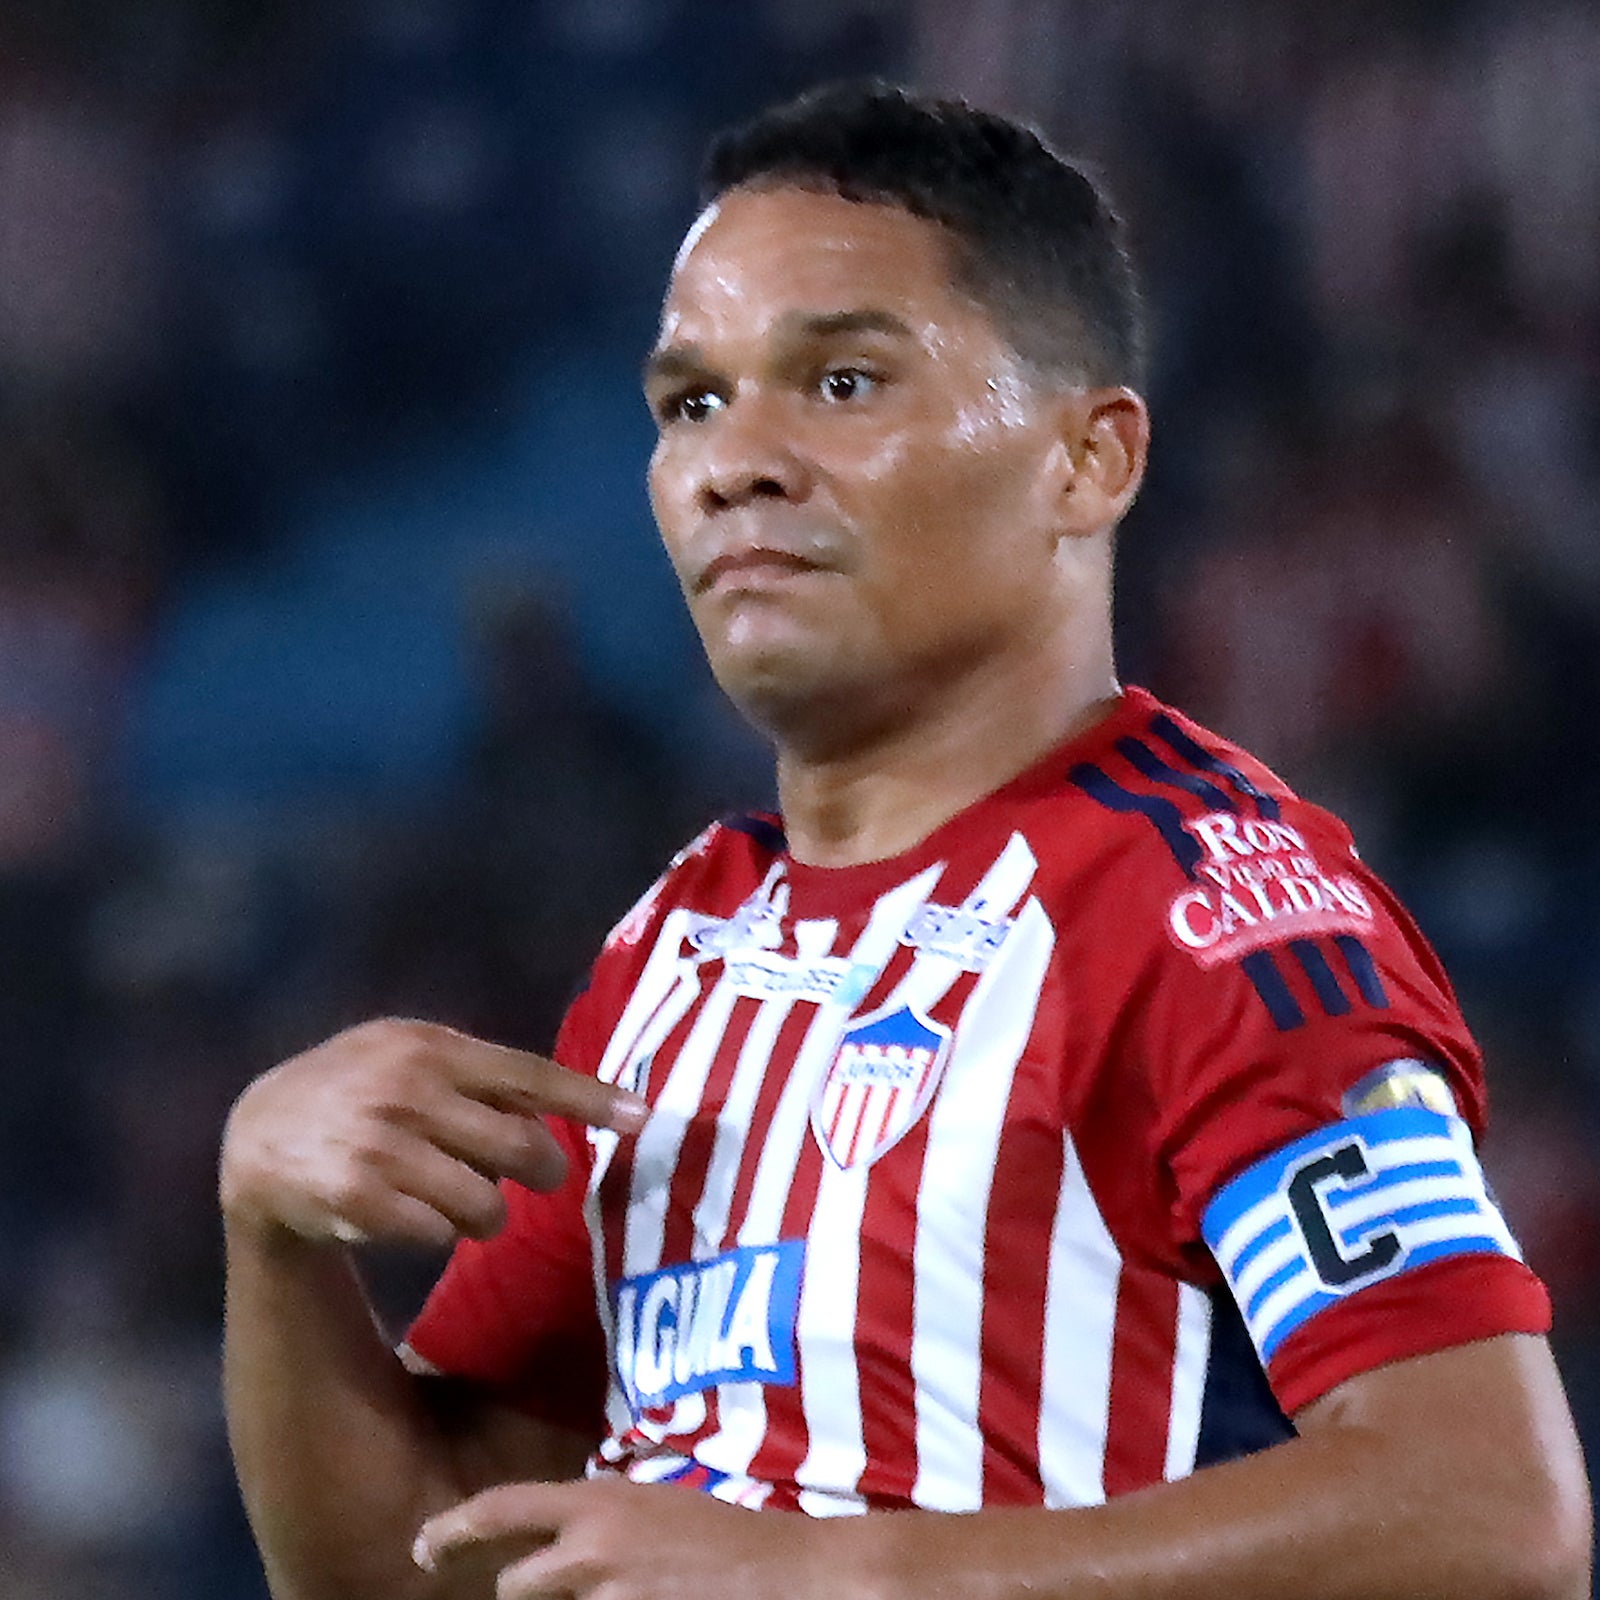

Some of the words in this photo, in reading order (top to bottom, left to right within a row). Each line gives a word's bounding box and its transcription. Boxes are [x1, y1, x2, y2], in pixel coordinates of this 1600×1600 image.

[1187, 812, 1305, 862] RON
[1169, 876, 1374, 949] CALDAS
[1286, 1138, 1406, 1290] C
